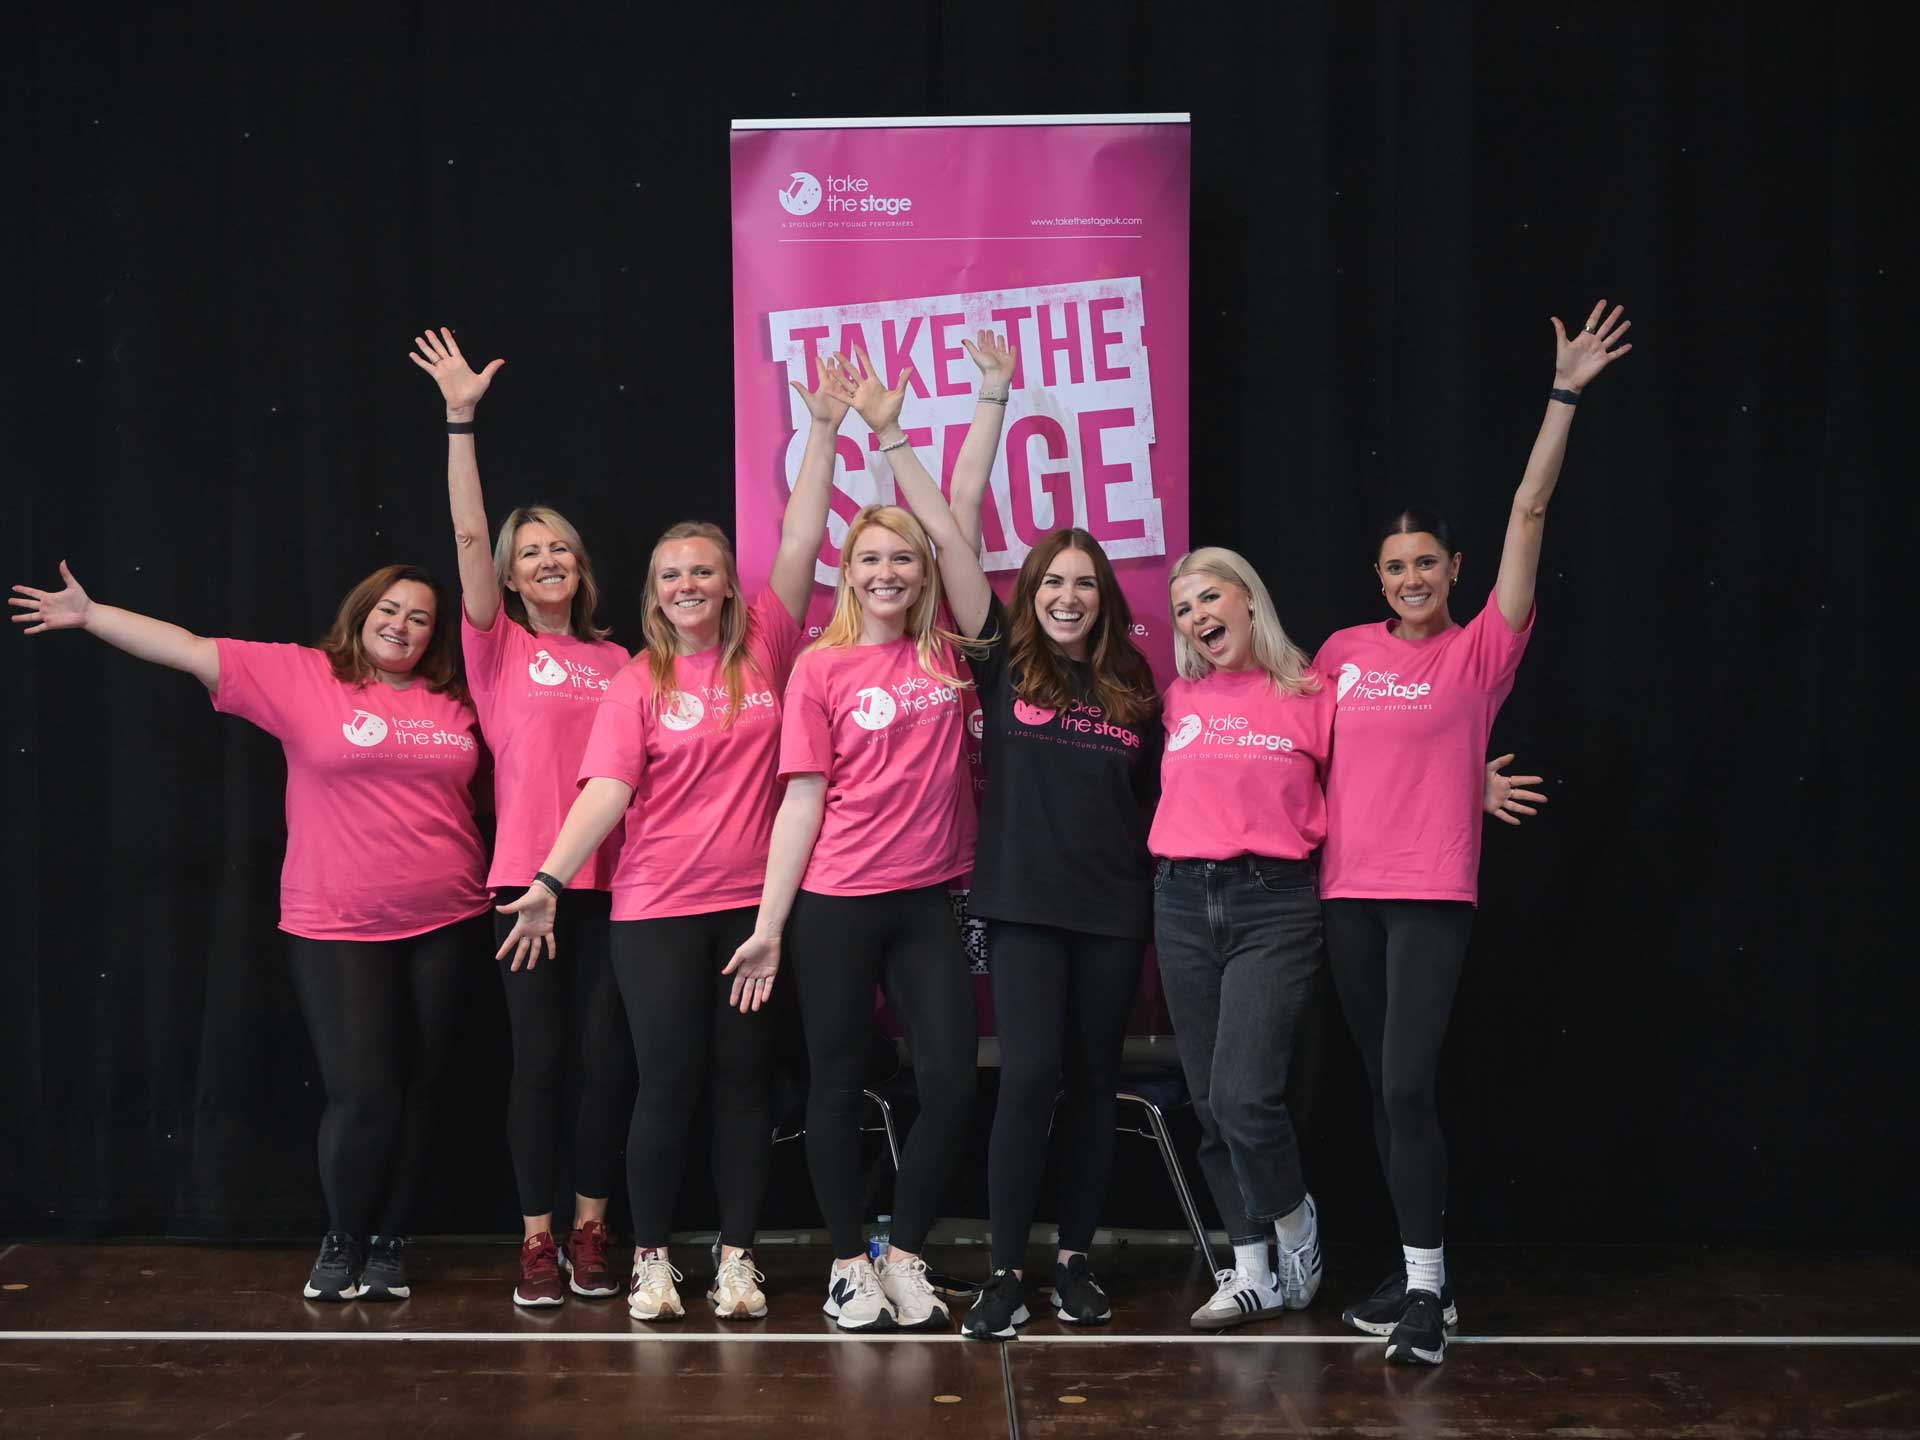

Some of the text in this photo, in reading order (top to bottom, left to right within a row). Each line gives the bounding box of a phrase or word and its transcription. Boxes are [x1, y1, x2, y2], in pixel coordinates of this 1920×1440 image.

[827, 175, 869, 192] take
[827, 194, 912, 215] the stage
[869, 220, 914, 228] PERFORMERS
[1030, 216, 1143, 227] www.takethestageuk.com
[789, 296, 1131, 399] TAKE THE
[701, 684, 729, 701] tak
[891, 676, 929, 698] take
[901, 685, 958, 716] the stag
[1069, 698, 1102, 717] ake
[1384, 703, 1433, 712] PERFORMERS
[392, 716, 435, 729] take
[1061, 714, 1140, 749] the stage
[1208, 714, 1249, 731] take
[395, 729, 474, 752] the stage
[1014, 730, 1053, 743] SPOTLIGHT
[1071, 740, 1097, 750] YOUNG
[1203, 730, 1293, 752] the stage
